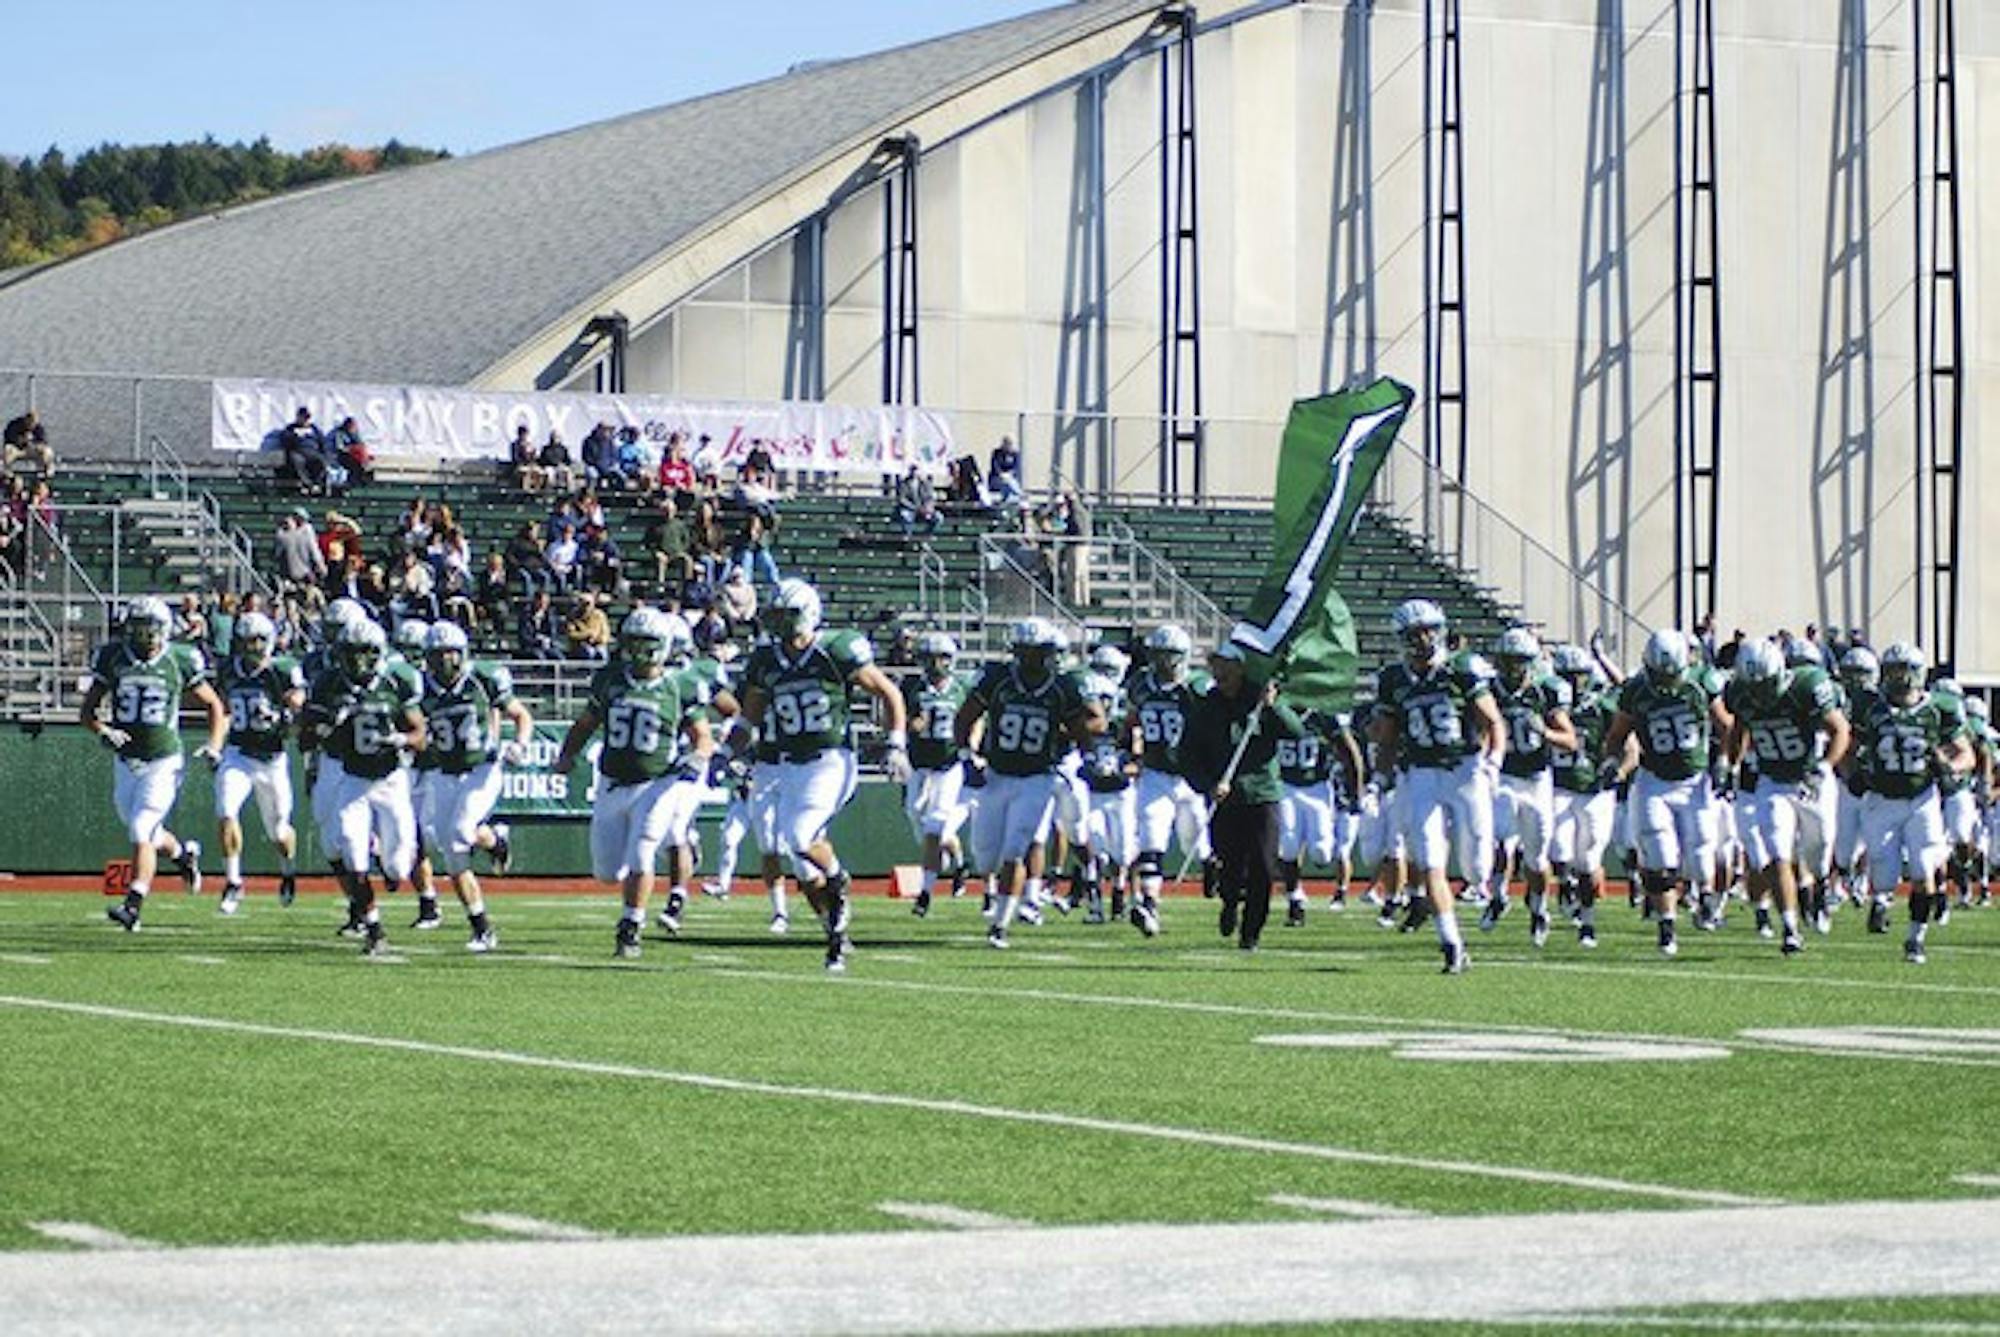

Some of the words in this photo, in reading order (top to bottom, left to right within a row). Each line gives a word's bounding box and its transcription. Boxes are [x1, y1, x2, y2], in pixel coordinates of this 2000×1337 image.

[473, 400, 573, 443] BOX
[608, 707, 661, 753] 56
[775, 690, 832, 734] 92
[502, 772, 568, 799] IONS
